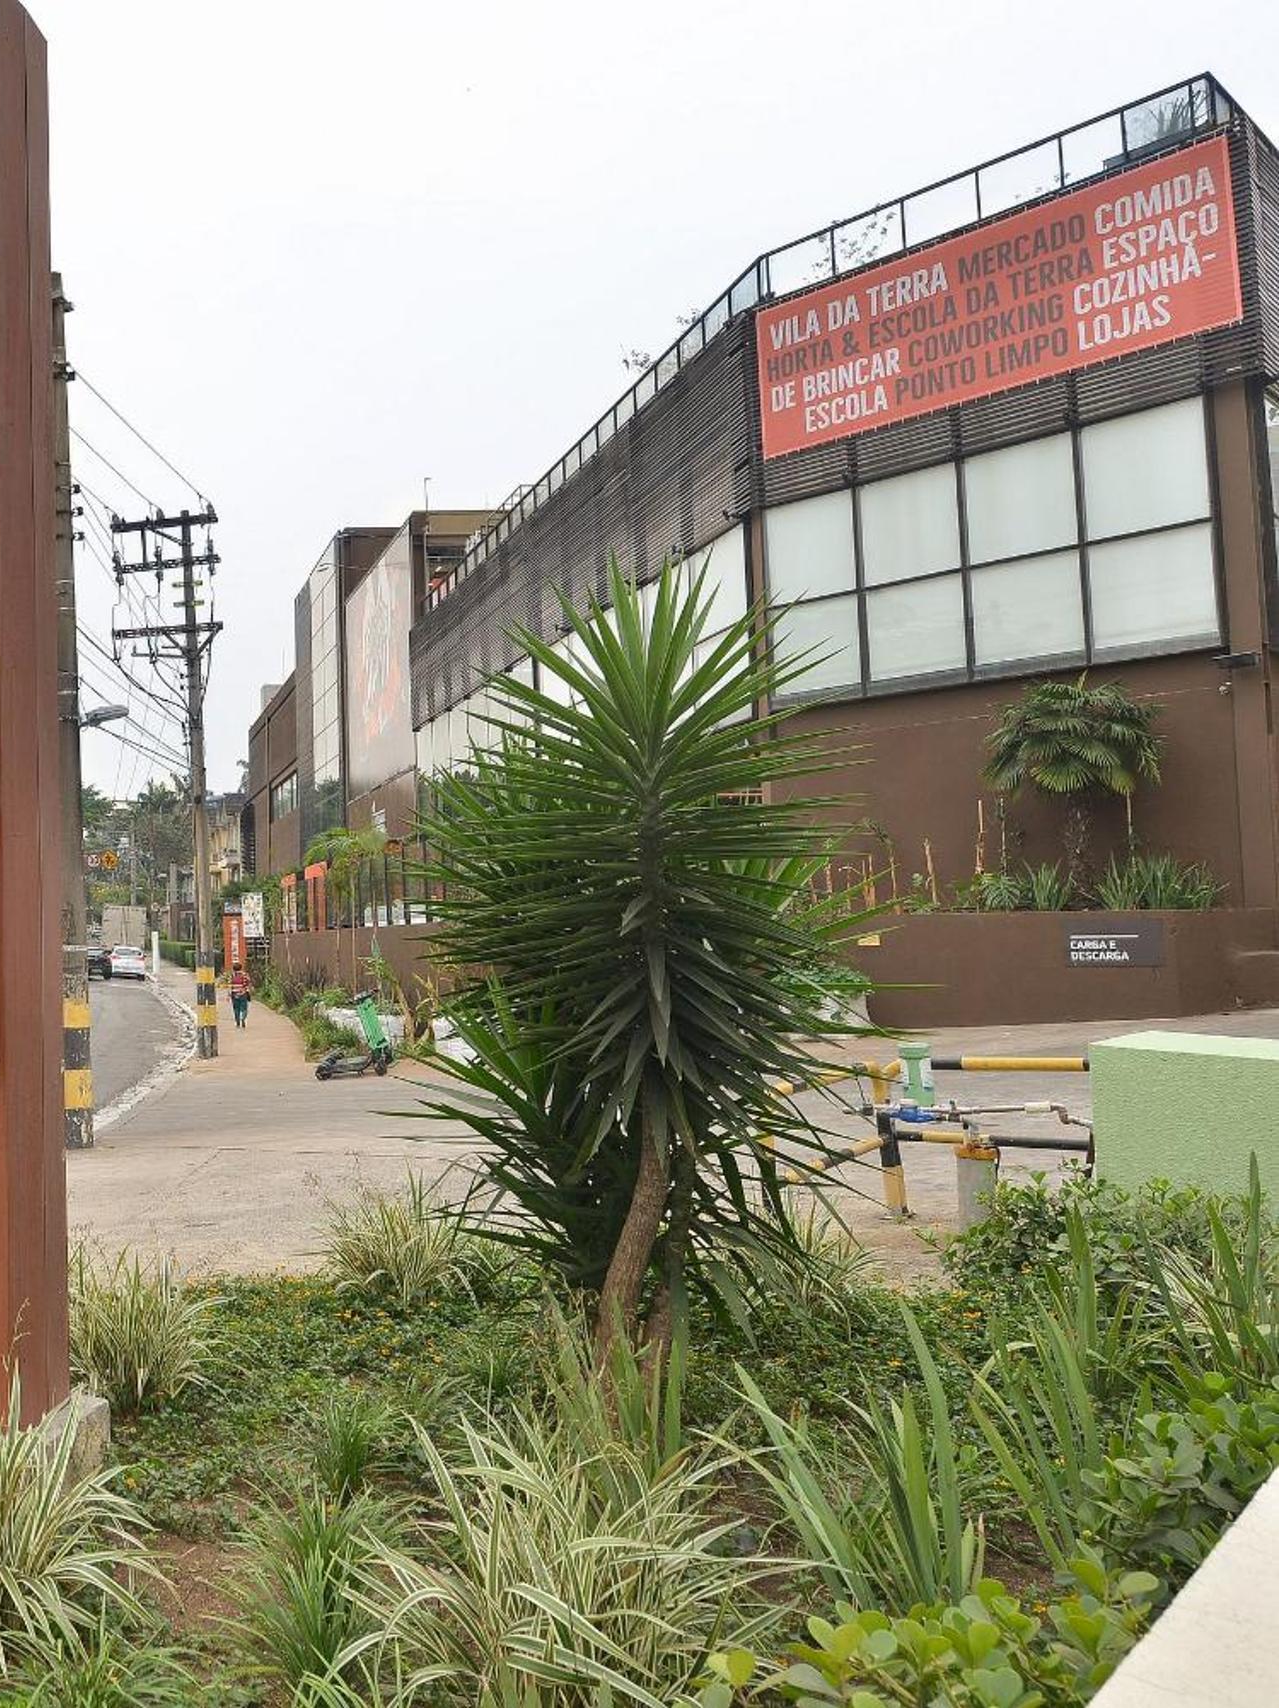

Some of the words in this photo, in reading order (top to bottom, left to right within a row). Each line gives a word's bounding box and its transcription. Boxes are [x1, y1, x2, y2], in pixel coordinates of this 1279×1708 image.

[767, 339, 834, 383] HORTA
[842, 330, 860, 356] &
[867, 295, 957, 348] ESCOLA
[966, 281, 1000, 315] DA
[1008, 247, 1094, 300] TERRA
[1102, 202, 1219, 269] ESPAÇO
[770, 309, 821, 350] VILA
[827, 294, 860, 332] DA
[866, 262, 949, 317] TERRA
[958, 213, 1086, 284] MERCADO
[1094, 166, 1216, 235] COMIDA
[772, 381, 796, 412] DE
[803, 347, 901, 402] BRINCAR
[908, 293, 1064, 367] COWORKING
[805, 385, 889, 434] ESCOLA
[894, 356, 976, 407] PONTO
[985, 327, 1069, 378] LIMPO
[1077, 294, 1171, 351] LOJAS
[1070, 940, 1108, 950] CARGA
[1109, 939, 1117, 949] E
[1070, 951, 1130, 961] DESCARGA
